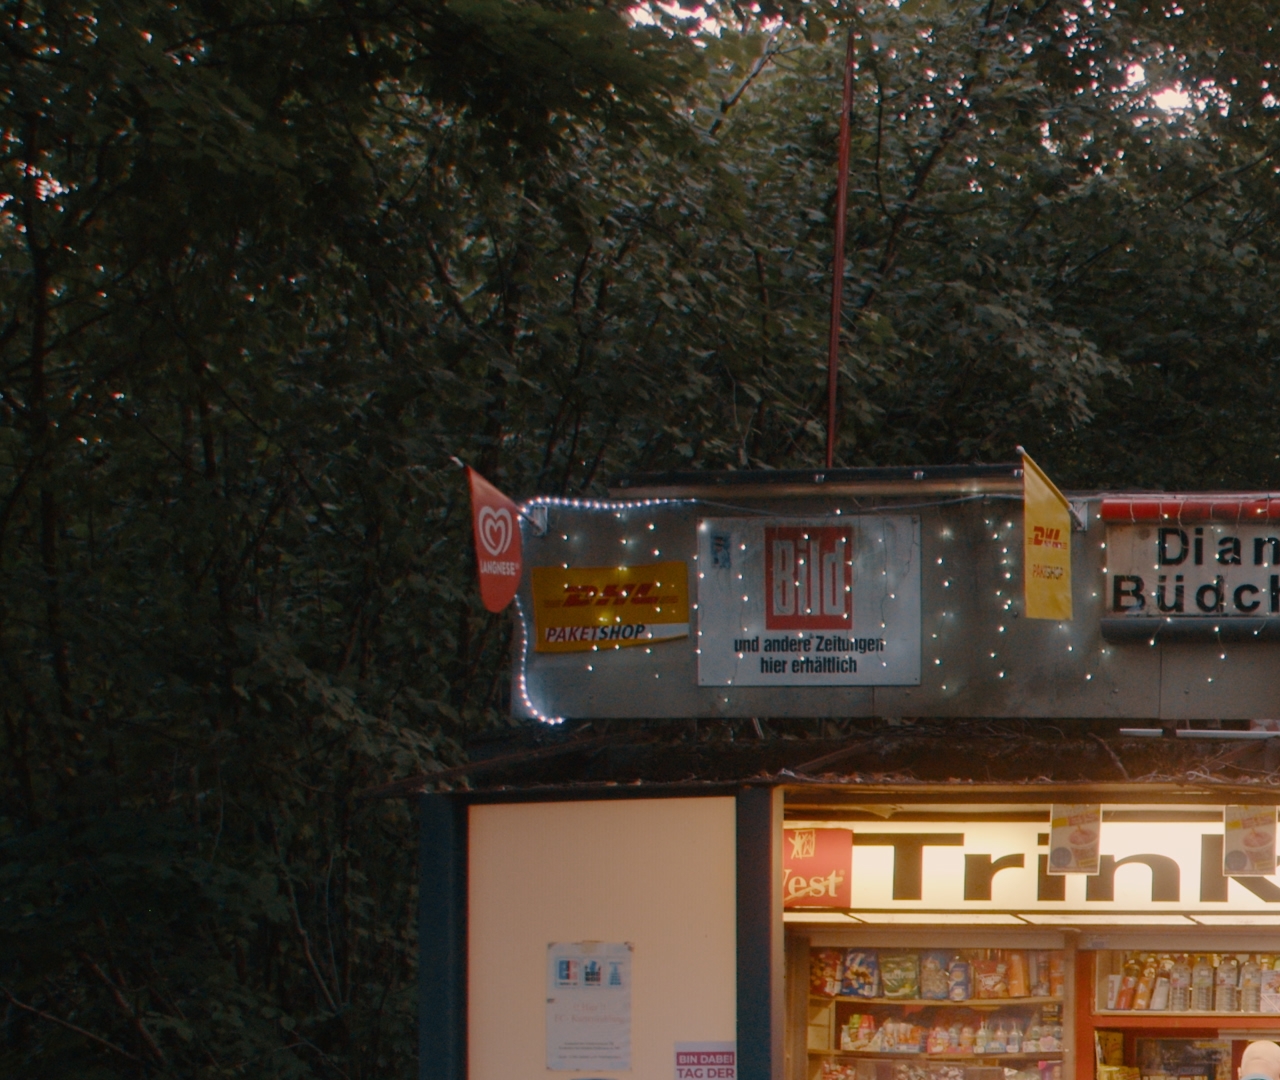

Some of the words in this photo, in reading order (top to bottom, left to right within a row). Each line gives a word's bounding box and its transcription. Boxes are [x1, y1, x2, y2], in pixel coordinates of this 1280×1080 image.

[773, 540, 846, 616] Bild
[563, 582, 659, 607] DHL
[545, 624, 645, 642] PAKETSHOP
[734, 636, 760, 653] und
[765, 636, 811, 653] andere
[816, 636, 884, 655] Zeitungen
[760, 657, 786, 674] hier
[790, 656, 857, 674] erhältlich
[783, 868, 838, 898] est
[680, 1055, 698, 1064] BIN
[701, 1055, 733, 1064] DABEI
[677, 1068, 703, 1078] TAG
[707, 1068, 734, 1078] DER
